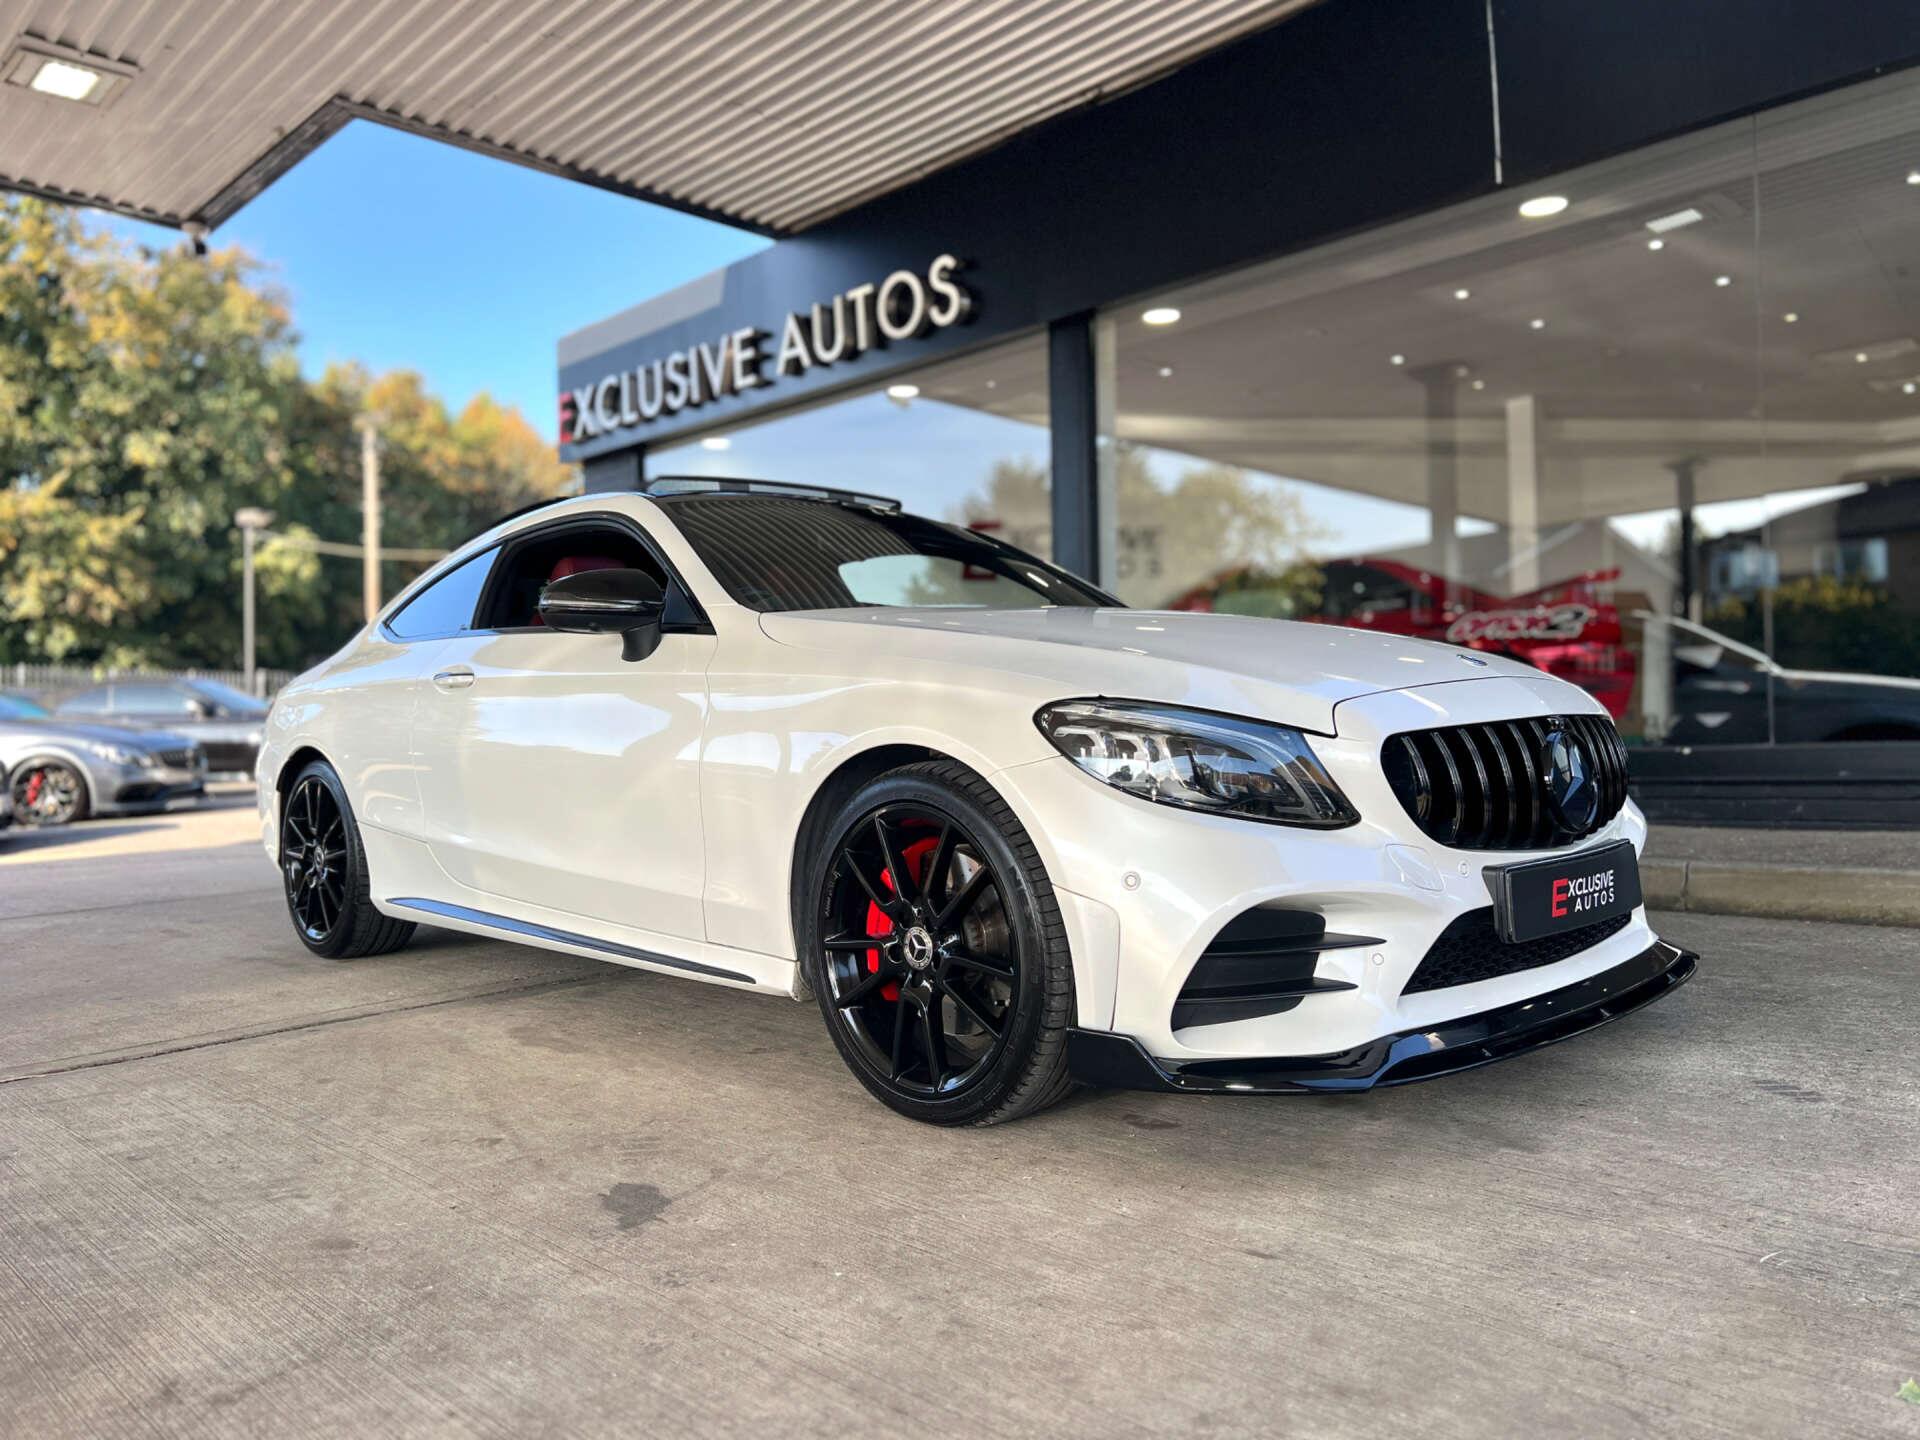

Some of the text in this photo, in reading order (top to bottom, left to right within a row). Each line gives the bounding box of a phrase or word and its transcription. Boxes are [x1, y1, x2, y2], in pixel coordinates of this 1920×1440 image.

[558, 253, 963, 444] EXCLUSIVE AUTOS
[1551, 869, 1614, 918] EXCLUSIVE
[1574, 888, 1615, 912] AUTOS
